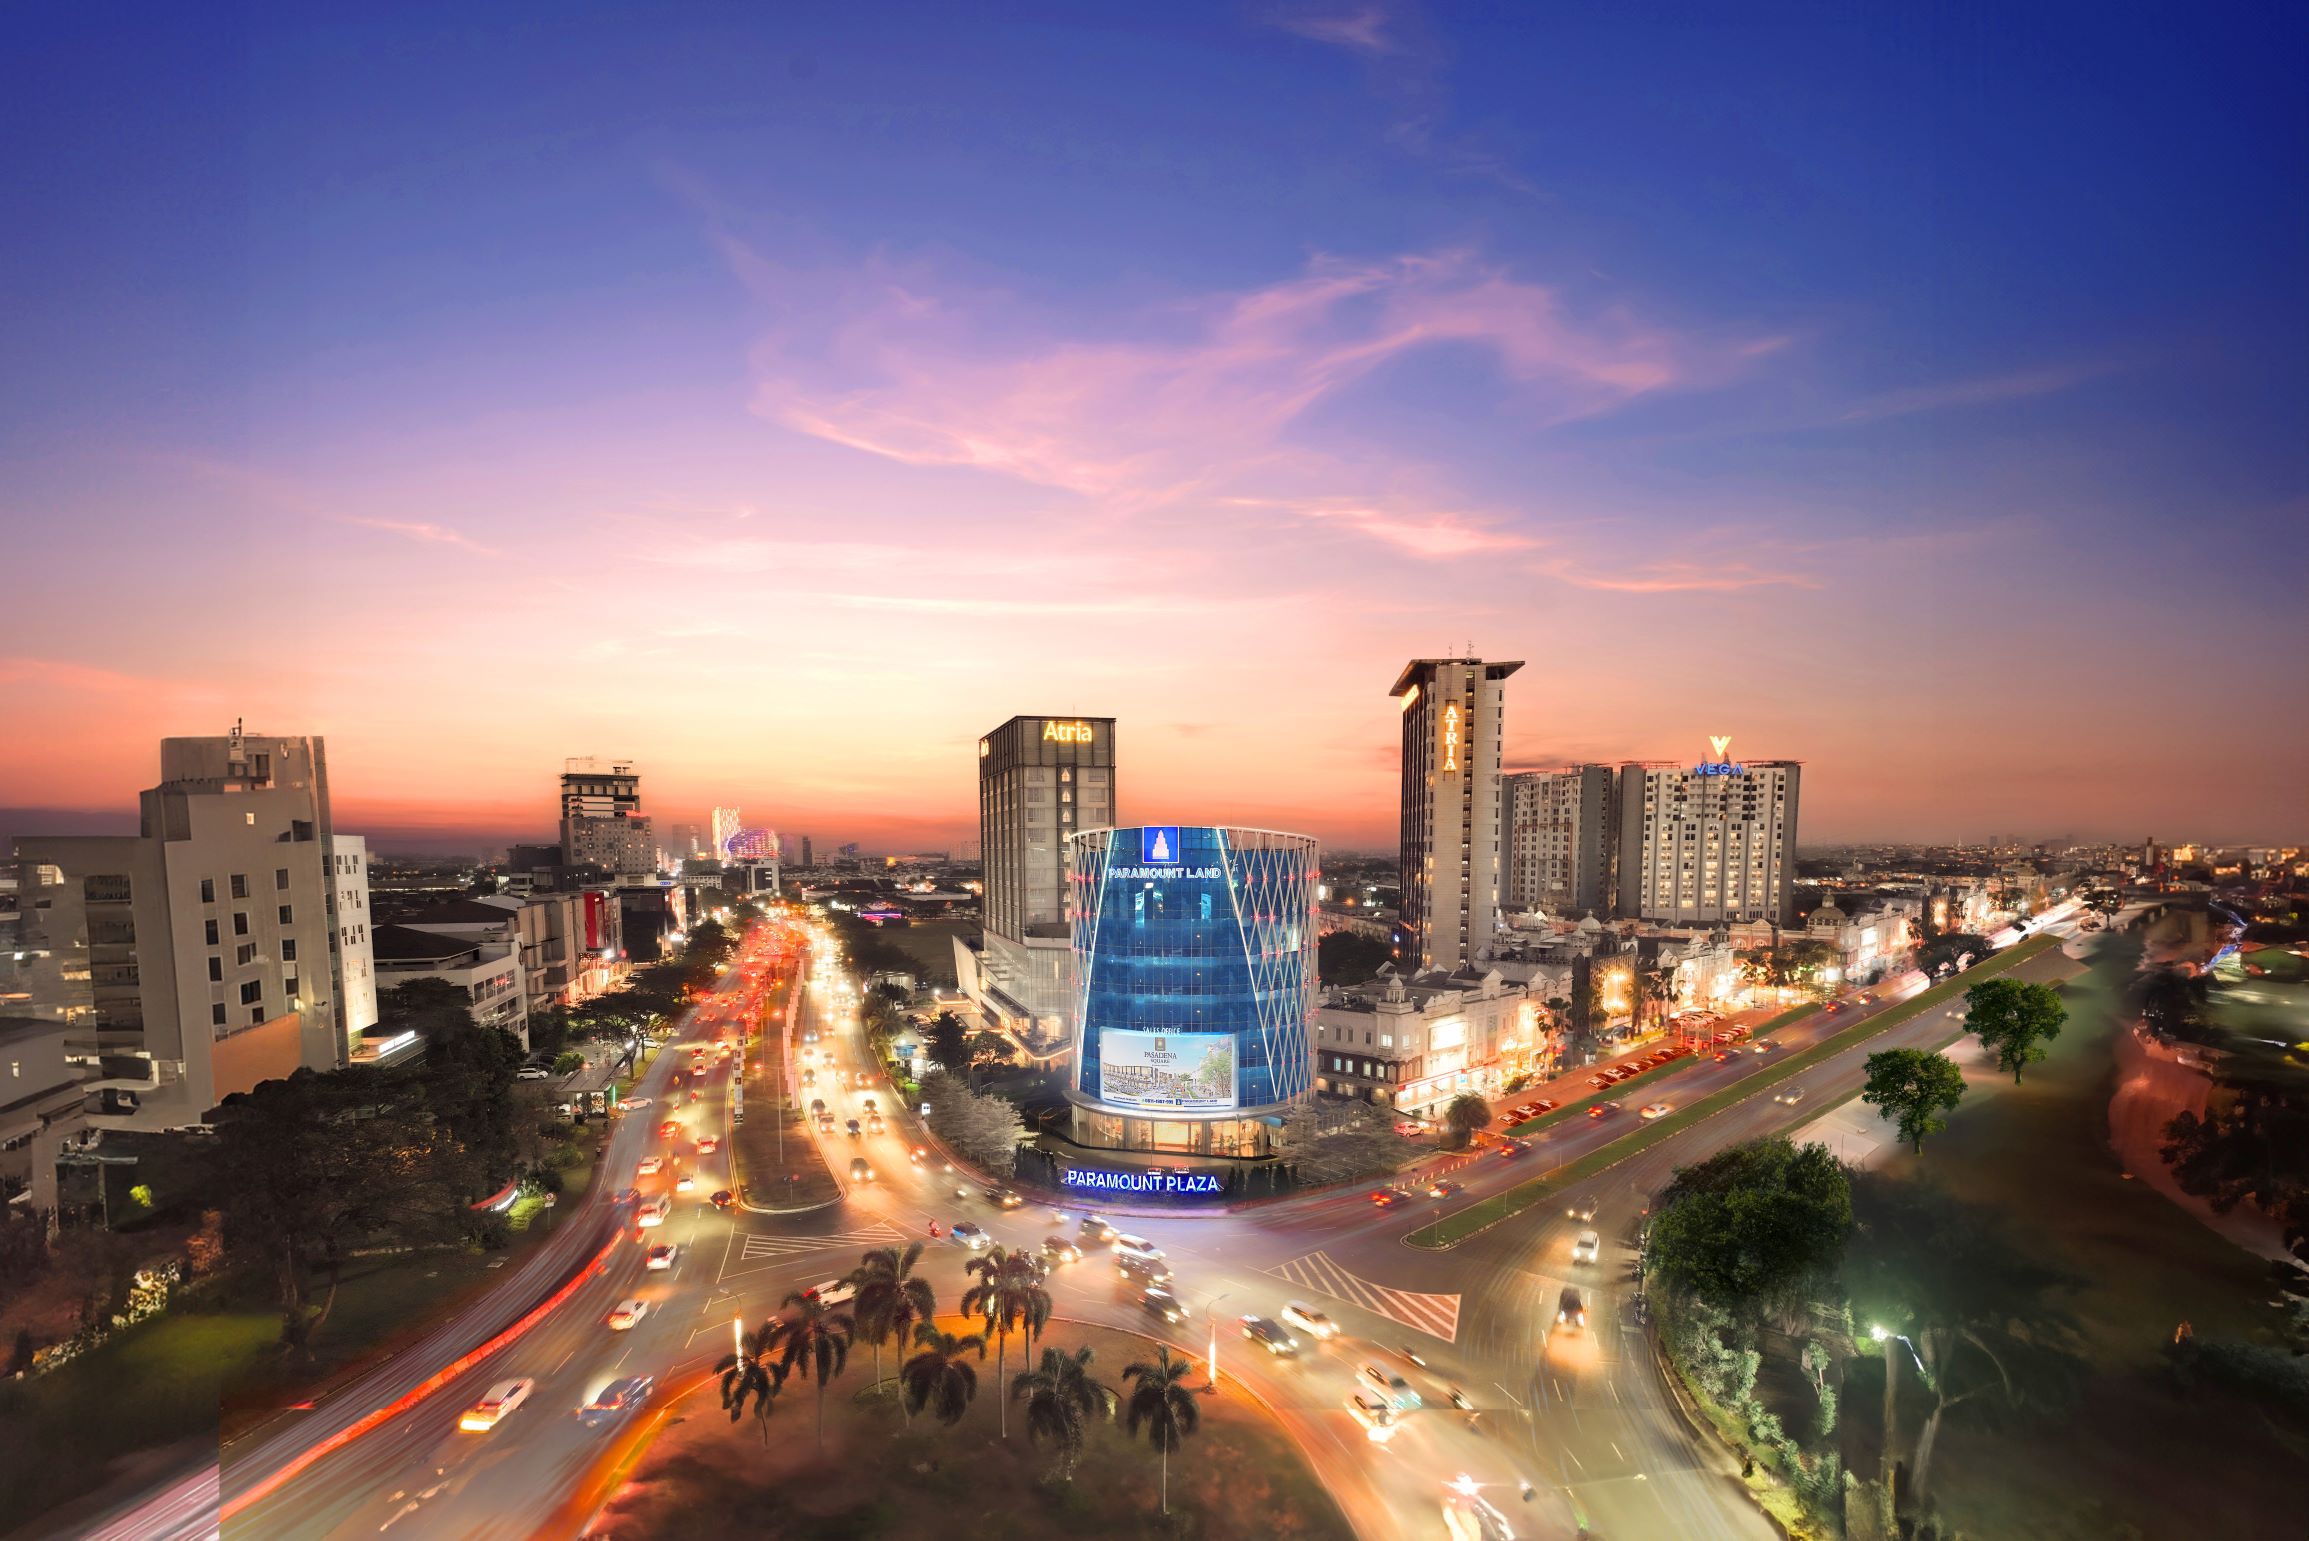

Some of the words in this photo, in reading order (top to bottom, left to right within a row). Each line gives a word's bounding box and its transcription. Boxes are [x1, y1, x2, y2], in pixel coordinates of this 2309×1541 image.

[1043, 720, 1093, 742] Atria
[1443, 706, 1458, 770] ATRIA
[1695, 763, 1743, 775] VEGA
[1108, 868, 1184, 879] PARAMOUNT
[1186, 868, 1222, 879] LAND
[1143, 1026, 1160, 1034] SALES
[1162, 1027, 1181, 1036] OFFICE
[1144, 1051, 1177, 1060] PASADENA
[1067, 1170, 1162, 1191] PARAMOUNT
[1166, 1176, 1218, 1192] PLAZA
